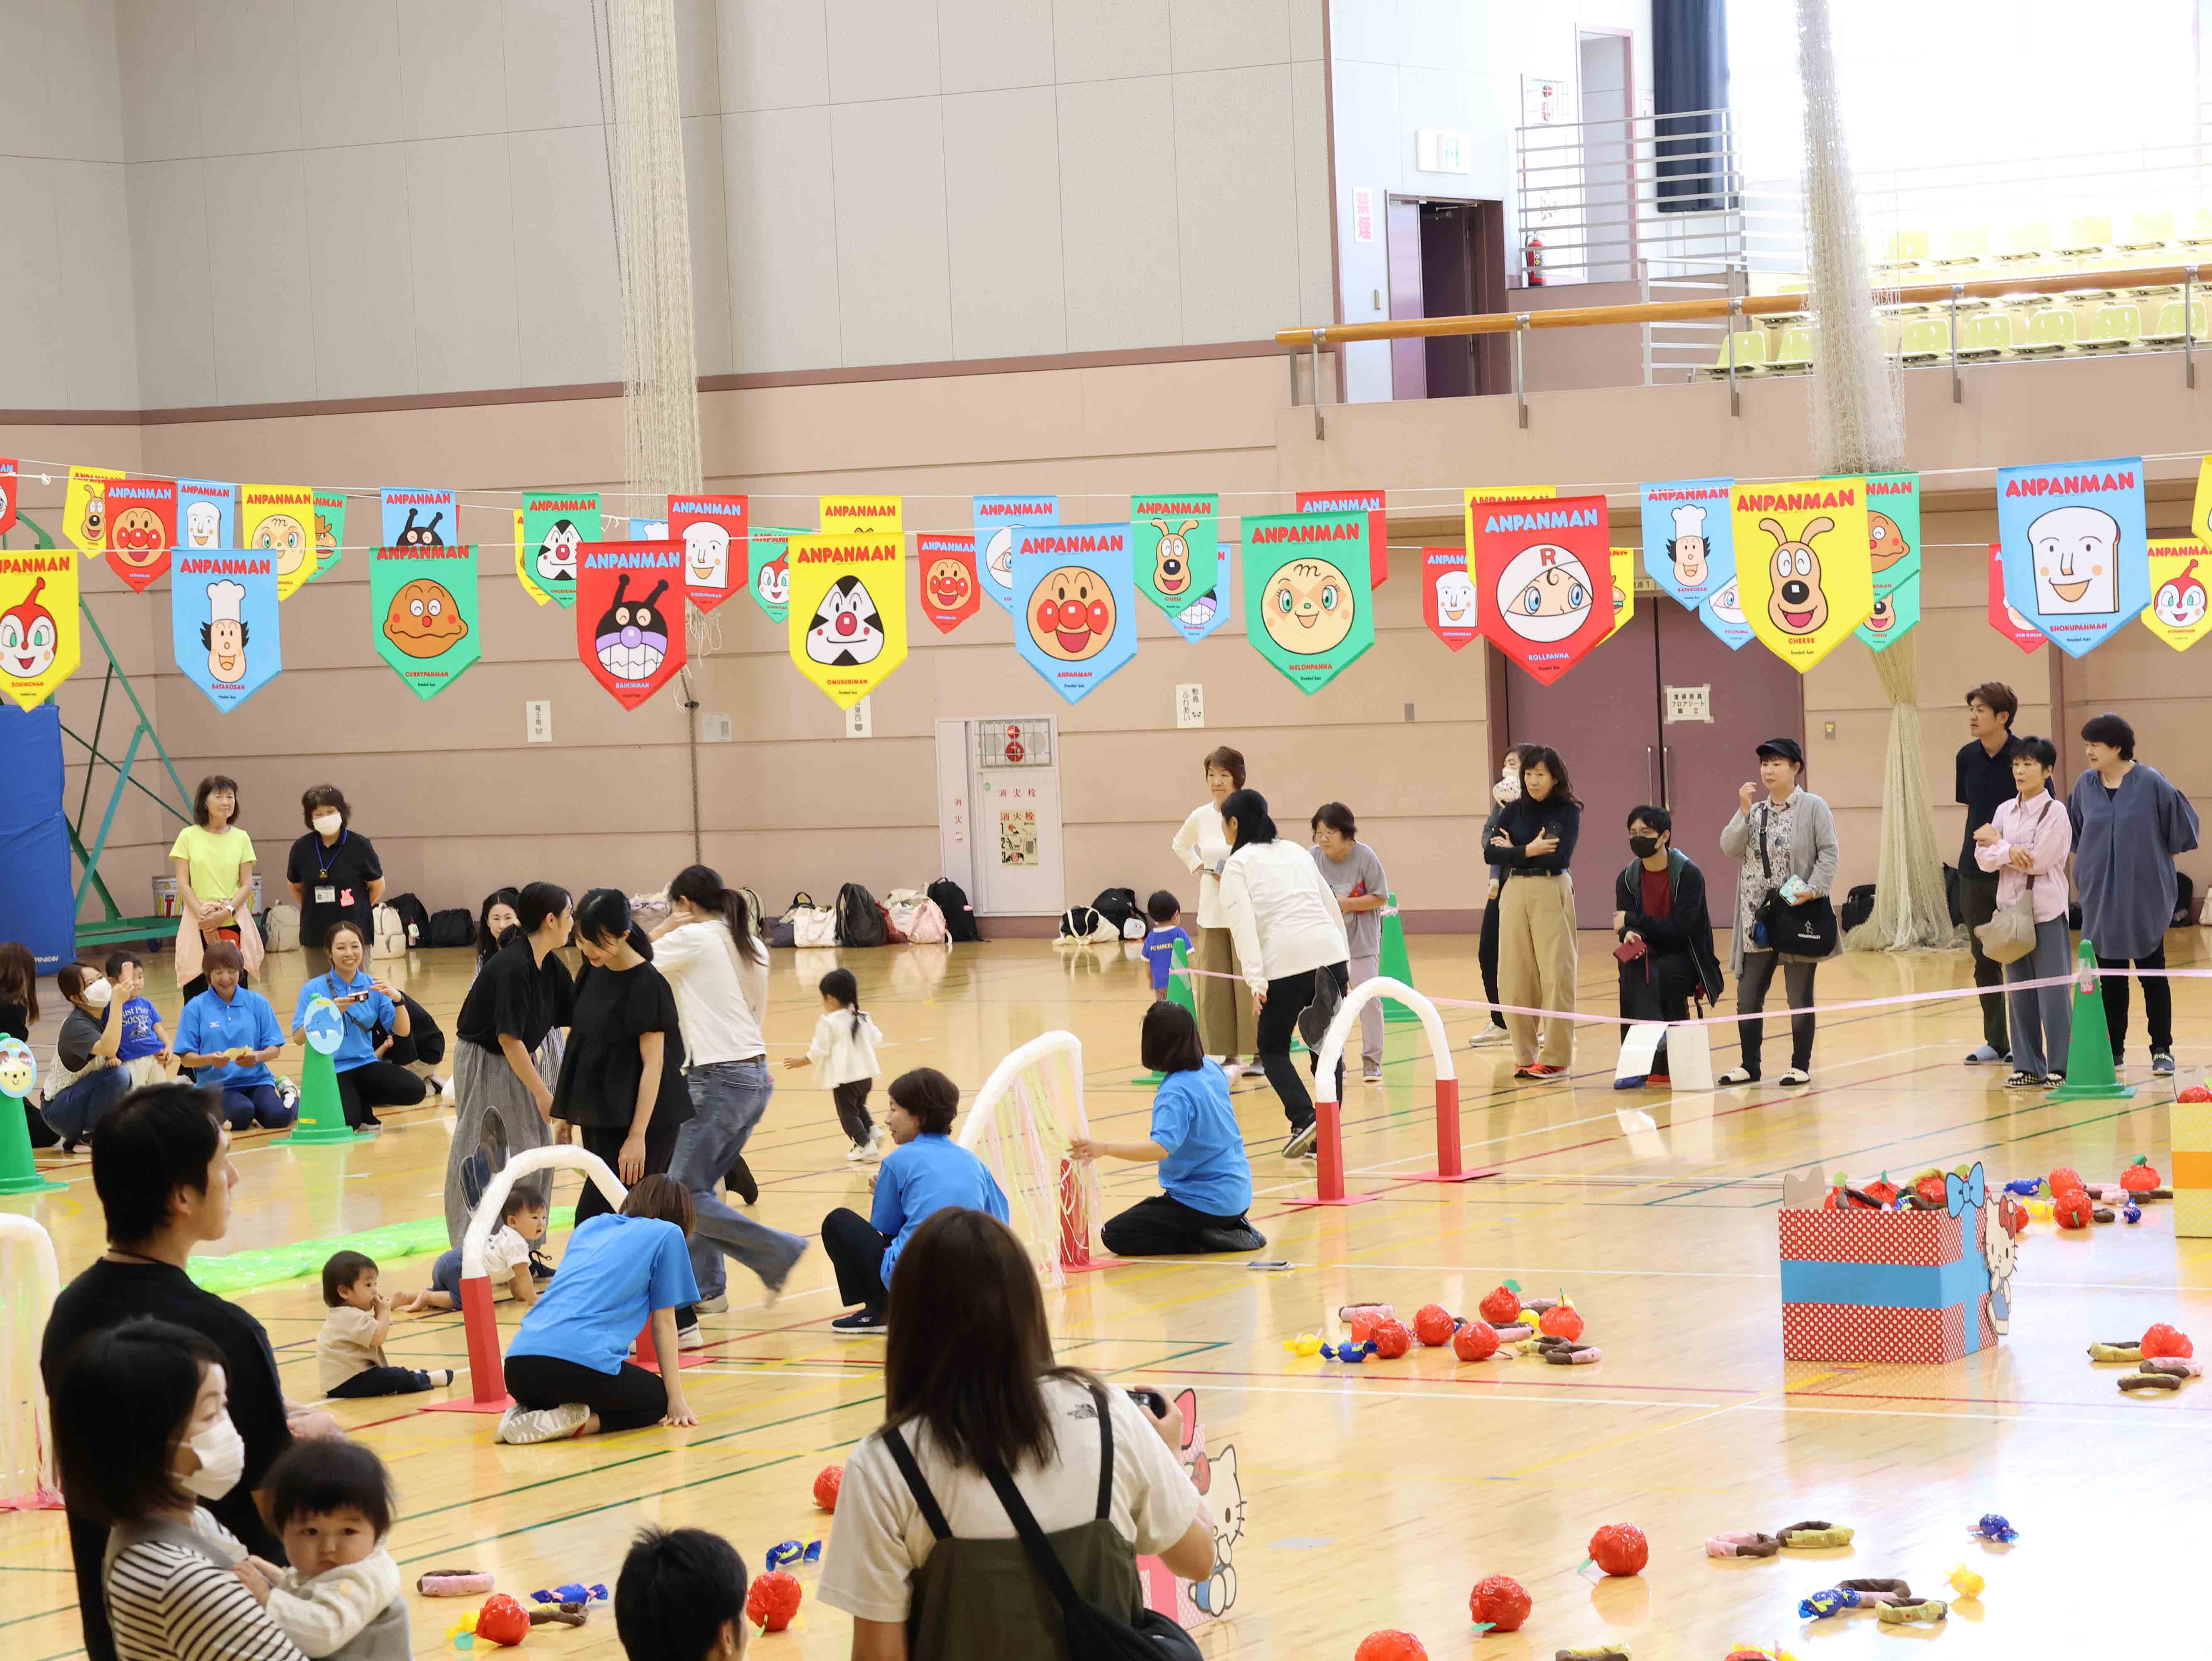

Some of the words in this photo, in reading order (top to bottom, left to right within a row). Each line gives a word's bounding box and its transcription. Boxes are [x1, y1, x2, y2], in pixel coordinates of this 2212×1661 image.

[1356, 191, 1371, 240] 禁煙
[1866, 481, 1912, 495] NMAN
[2006, 472, 2134, 497] ANPANMAN
[108, 487, 171, 499] ANPANMAN
[181, 485, 229, 497] ANPANMAN
[1649, 488, 1728, 501] ANPANMAN
[246, 494, 311, 505] ANPANMAN
[313, 497, 343, 508] NMAN
[387, 493, 451, 505] ANPANMAN
[530, 499, 596, 511] ANPANMAN
[1303, 498, 1380, 512] ANPANMAN
[1737, 489, 1855, 512] ANPANMAN
[673, 502, 741, 516] ANPANMAN
[825, 505, 896, 517] ANPANMAN
[980, 503, 1053, 515] ANPANMAN
[1137, 502, 1211, 514] ANPANMAN
[1485, 509, 1598, 532] ANPANMAN
[1252, 523, 1359, 544] ANPANMAN
[922, 541, 976, 552] ANPANMAN
[1020, 534, 1123, 554] ANPANMAN
[377, 544, 470, 560] ANPANMAN
[798, 545, 896, 563] ANPANMAN
[1540, 548, 1556, 566] R
[2147, 545, 2212, 558] ANPANMA
[0, 556, 70, 574] PANMAN
[584, 551, 680, 569] ANPANMAN
[180, 558, 271, 575] ANPANMAN
[2050, 623, 2108, 632] SHOKUPANMAN
[1528, 652, 1569, 661] ROLLPANNA
[998, 788, 1036, 798] 消火栓
[1001, 812, 1035, 821] 消火栓
[1001, 823, 1004, 835] 1
[1001, 837, 1005, 849] 2
[1002, 851, 1006, 863] 3
